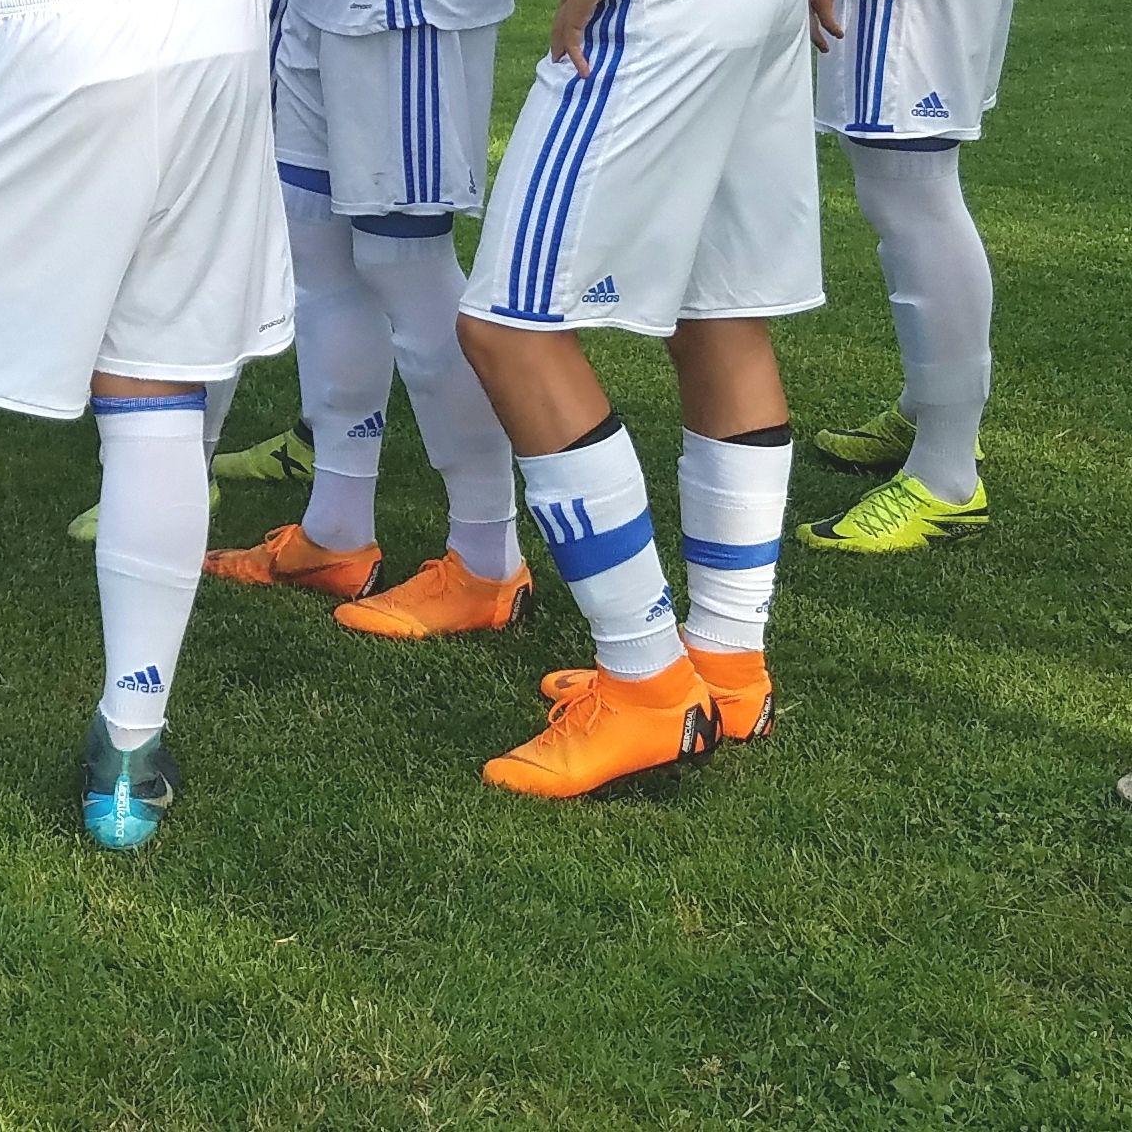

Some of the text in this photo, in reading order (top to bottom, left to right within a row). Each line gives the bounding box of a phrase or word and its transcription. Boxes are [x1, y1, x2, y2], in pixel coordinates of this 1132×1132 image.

[911, 107, 949, 118] adidas
[581, 292, 620, 303] adidas
[116, 680, 165, 694] adidas
